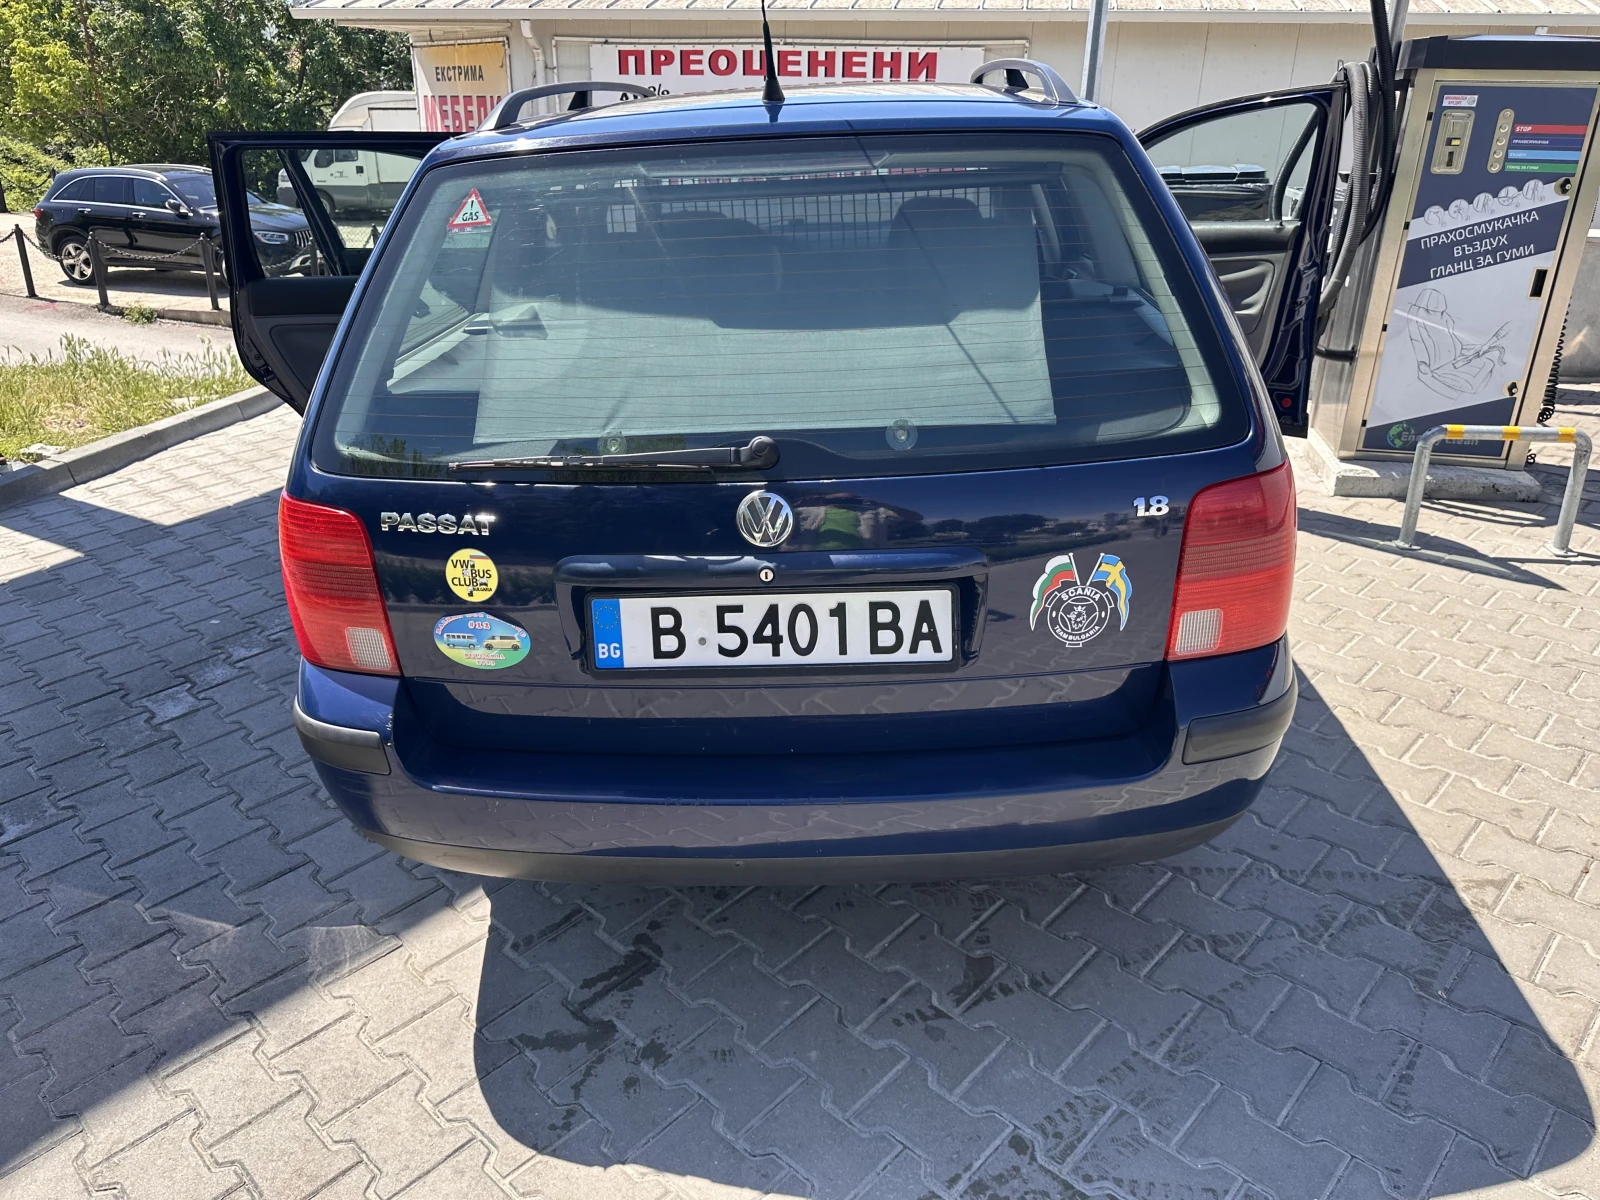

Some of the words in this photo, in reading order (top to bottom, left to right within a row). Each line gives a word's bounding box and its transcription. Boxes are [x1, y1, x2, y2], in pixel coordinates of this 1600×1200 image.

[435, 64, 485, 82] ЕКСТРИМА
[618, 49, 938, 81] ПРЕОЦЕНЕНИ
[462, 211, 479, 222] GAS
[1420, 210, 1539, 250] ПРАХОСМУКАЧКА
[1453, 234, 1508, 257] ВЪЗДУХ
[1430, 259, 1474, 279] ГЛАНЦ
[1476, 254, 1494, 268] ЗА
[1496, 243, 1535, 263] ГУМИ
[380, 511, 496, 536] PASSAT
[451, 559, 470, 569] VW
[451, 577, 479, 587] CLUB
[470, 569, 492, 579] BUS
[1061, 587, 1100, 602] SCANIA
[650, 606, 687, 660] B
[716, 602, 848, 658] 5401
[868, 599, 943, 655] BA
[1054, 625, 1069, 639] TEAM
[1068, 625, 1100, 641] BULGARIA
[597, 643, 621, 659] BG
